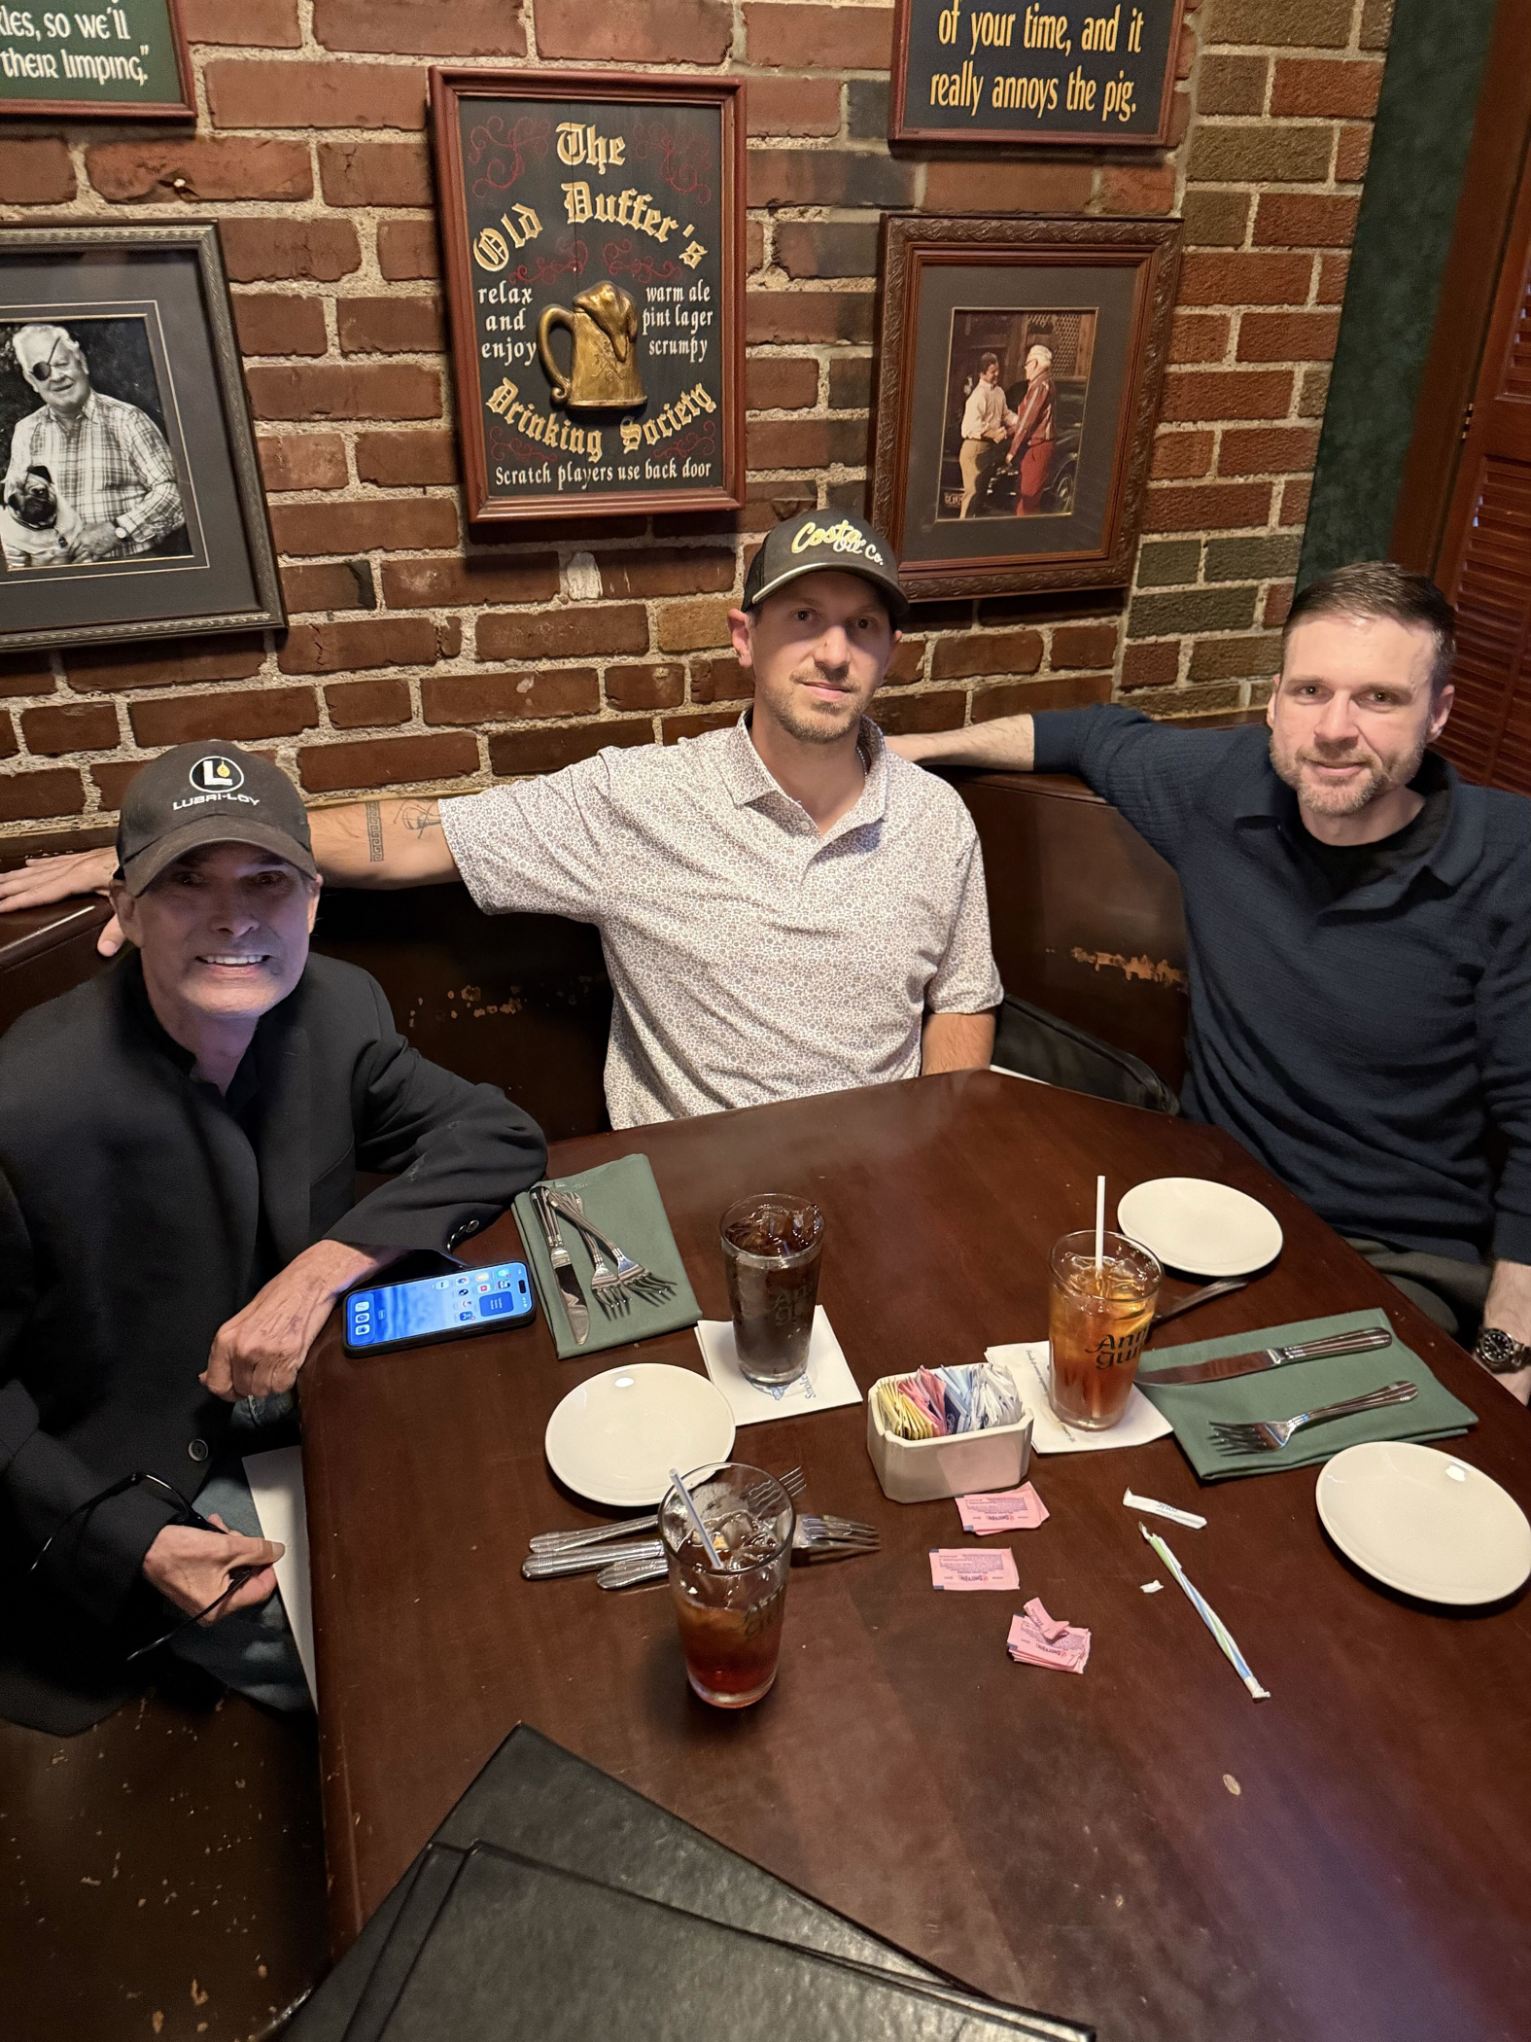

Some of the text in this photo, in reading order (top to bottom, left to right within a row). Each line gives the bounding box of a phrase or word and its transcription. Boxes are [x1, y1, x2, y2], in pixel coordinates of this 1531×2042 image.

[43, 12, 71, 38] so
[74, 7, 131, 40] we'll
[970, 12, 1016, 55] your
[1023, 2, 1072, 56] time,
[1081, 4, 1121, 52] and
[1127, 7, 1144, 53] it
[929, 60, 1137, 122] really annoys the pig.
[555, 121, 626, 175] The
[472, 180, 708, 273] Old Duffer's
[477, 280, 533, 306] relax
[645, 279, 711, 303] warm ale
[485, 308, 526, 332] and
[642, 304, 713, 335] pint lager
[481, 336, 537, 366] enjoy
[648, 337, 708, 363] scrumpy
[485, 376, 717, 464] Drinking Society
[495, 457, 712, 491] Scratch players use back door
[791, 519, 863, 553] Costa
[203, 760, 233, 786] L
